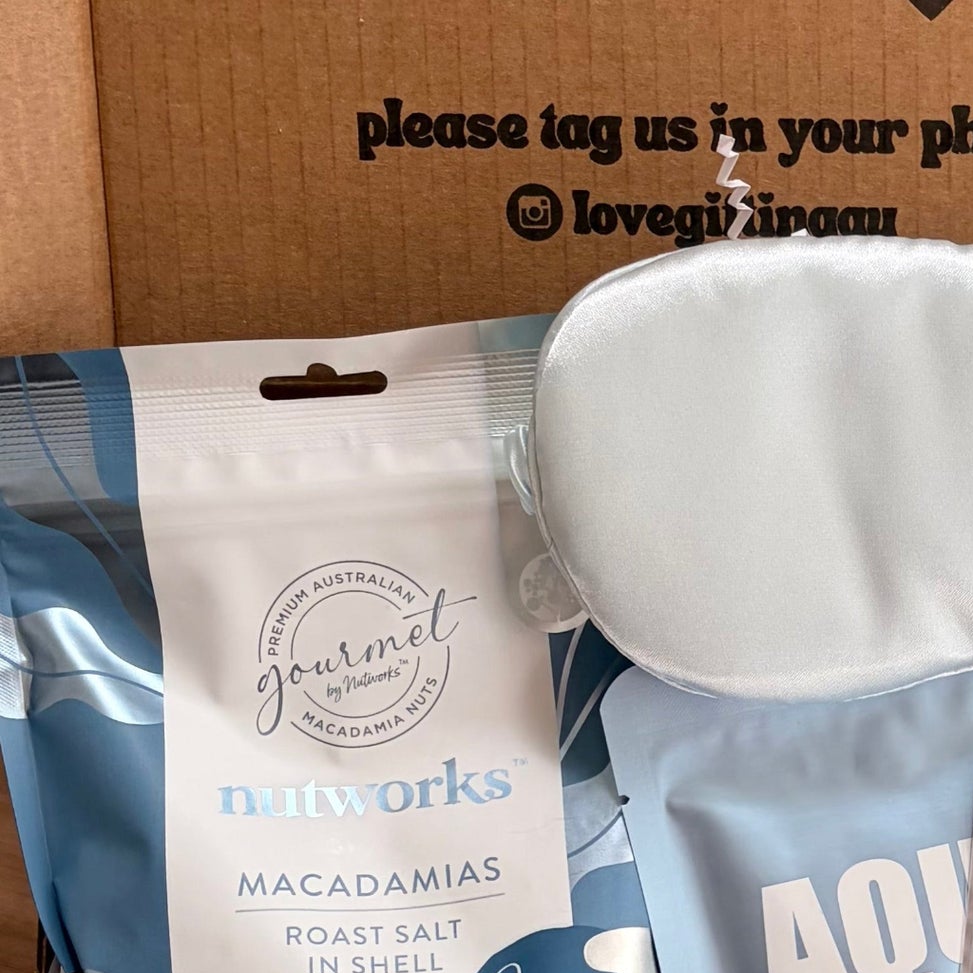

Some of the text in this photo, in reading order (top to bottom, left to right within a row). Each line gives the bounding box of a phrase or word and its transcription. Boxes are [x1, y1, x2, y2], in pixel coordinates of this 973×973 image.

[356, 97, 529, 161] please
[540, 103, 623, 165] tag
[634, 116, 699, 152] us
[709, 102, 769, 153] in
[777, 116, 909, 168] your
[267, 571, 416, 657] PREMIUM AUSTRALIAN
[256, 588, 477, 736] gourmet
[326, 682, 342, 703] by
[302, 675, 438, 739] MACADAMIA NUTS
[237, 856, 502, 897] MACADAMIAS
[286, 918, 462, 947] ROAST SALT
